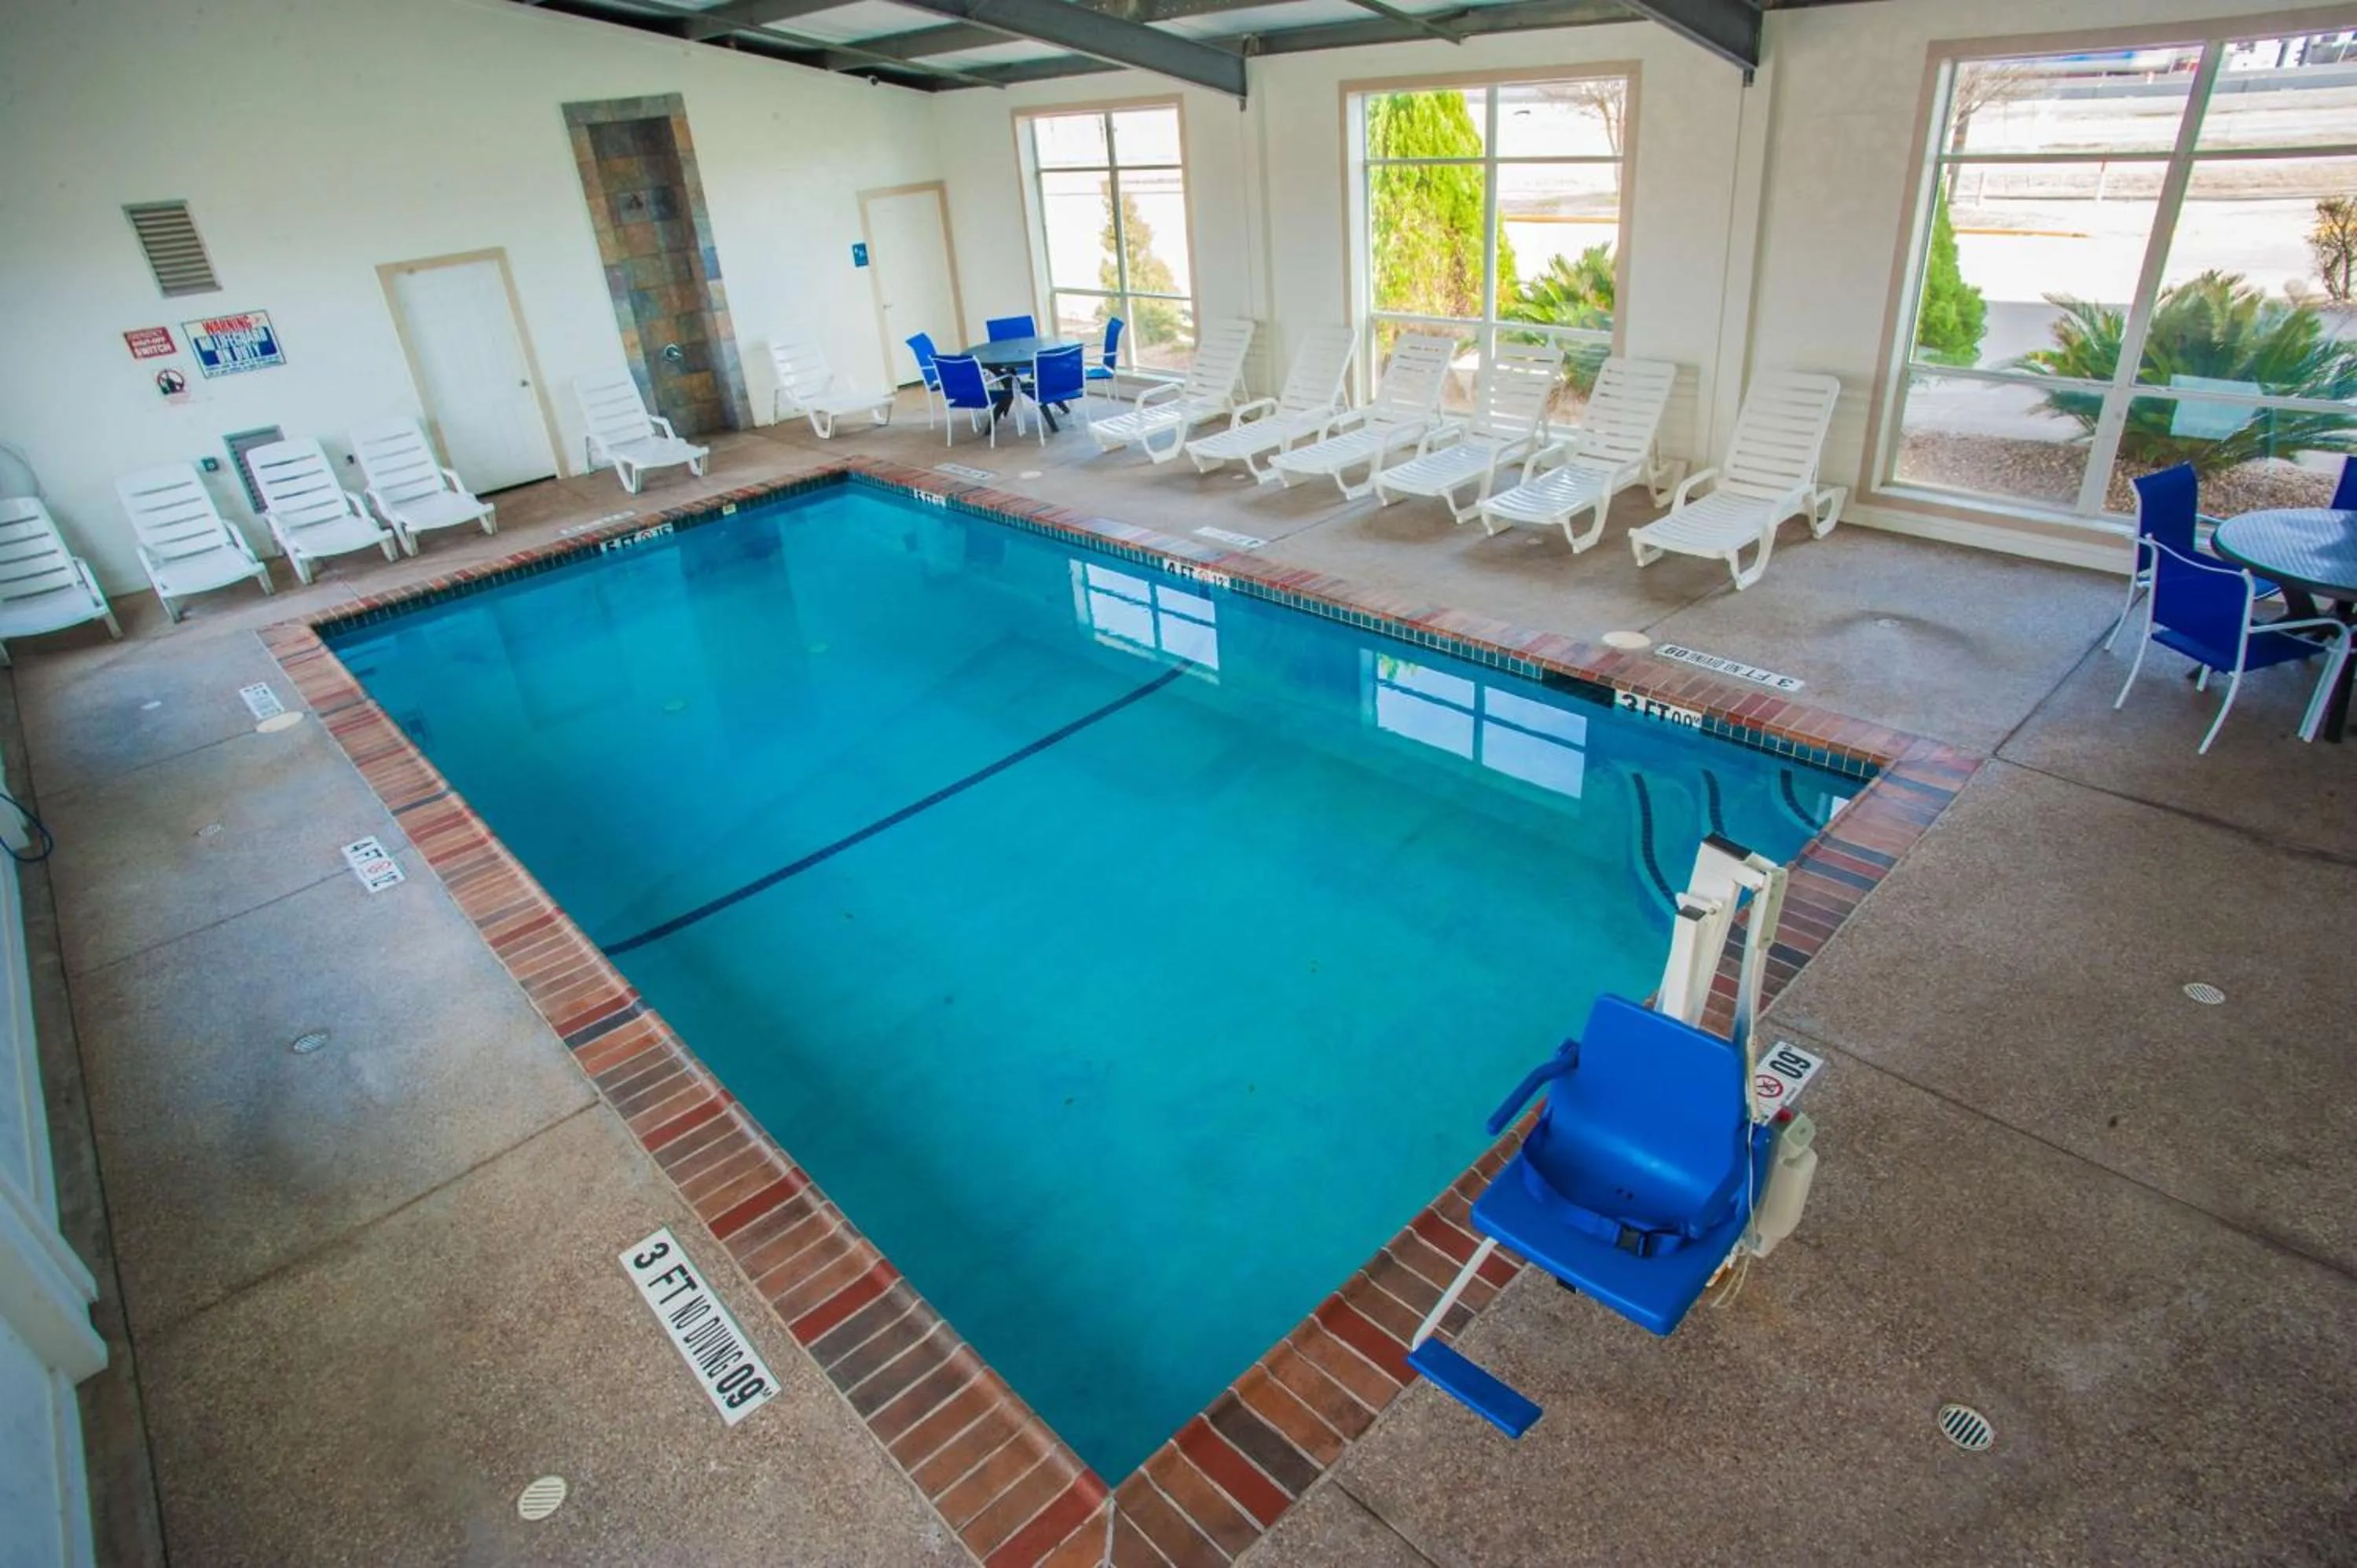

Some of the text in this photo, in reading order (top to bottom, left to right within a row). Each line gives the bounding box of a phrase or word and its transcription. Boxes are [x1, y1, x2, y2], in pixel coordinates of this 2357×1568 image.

[201, 315, 253, 335] WARNING
[1741, 669, 1772, 681] FT
[1777, 678, 1794, 687] 3
[1644, 699, 1671, 721] FT
[633, 1242, 670, 1269] 3
[647, 1263, 698, 1305] FT
[668, 1294, 712, 1330] NO
[682, 1316, 745, 1380] DIVING
